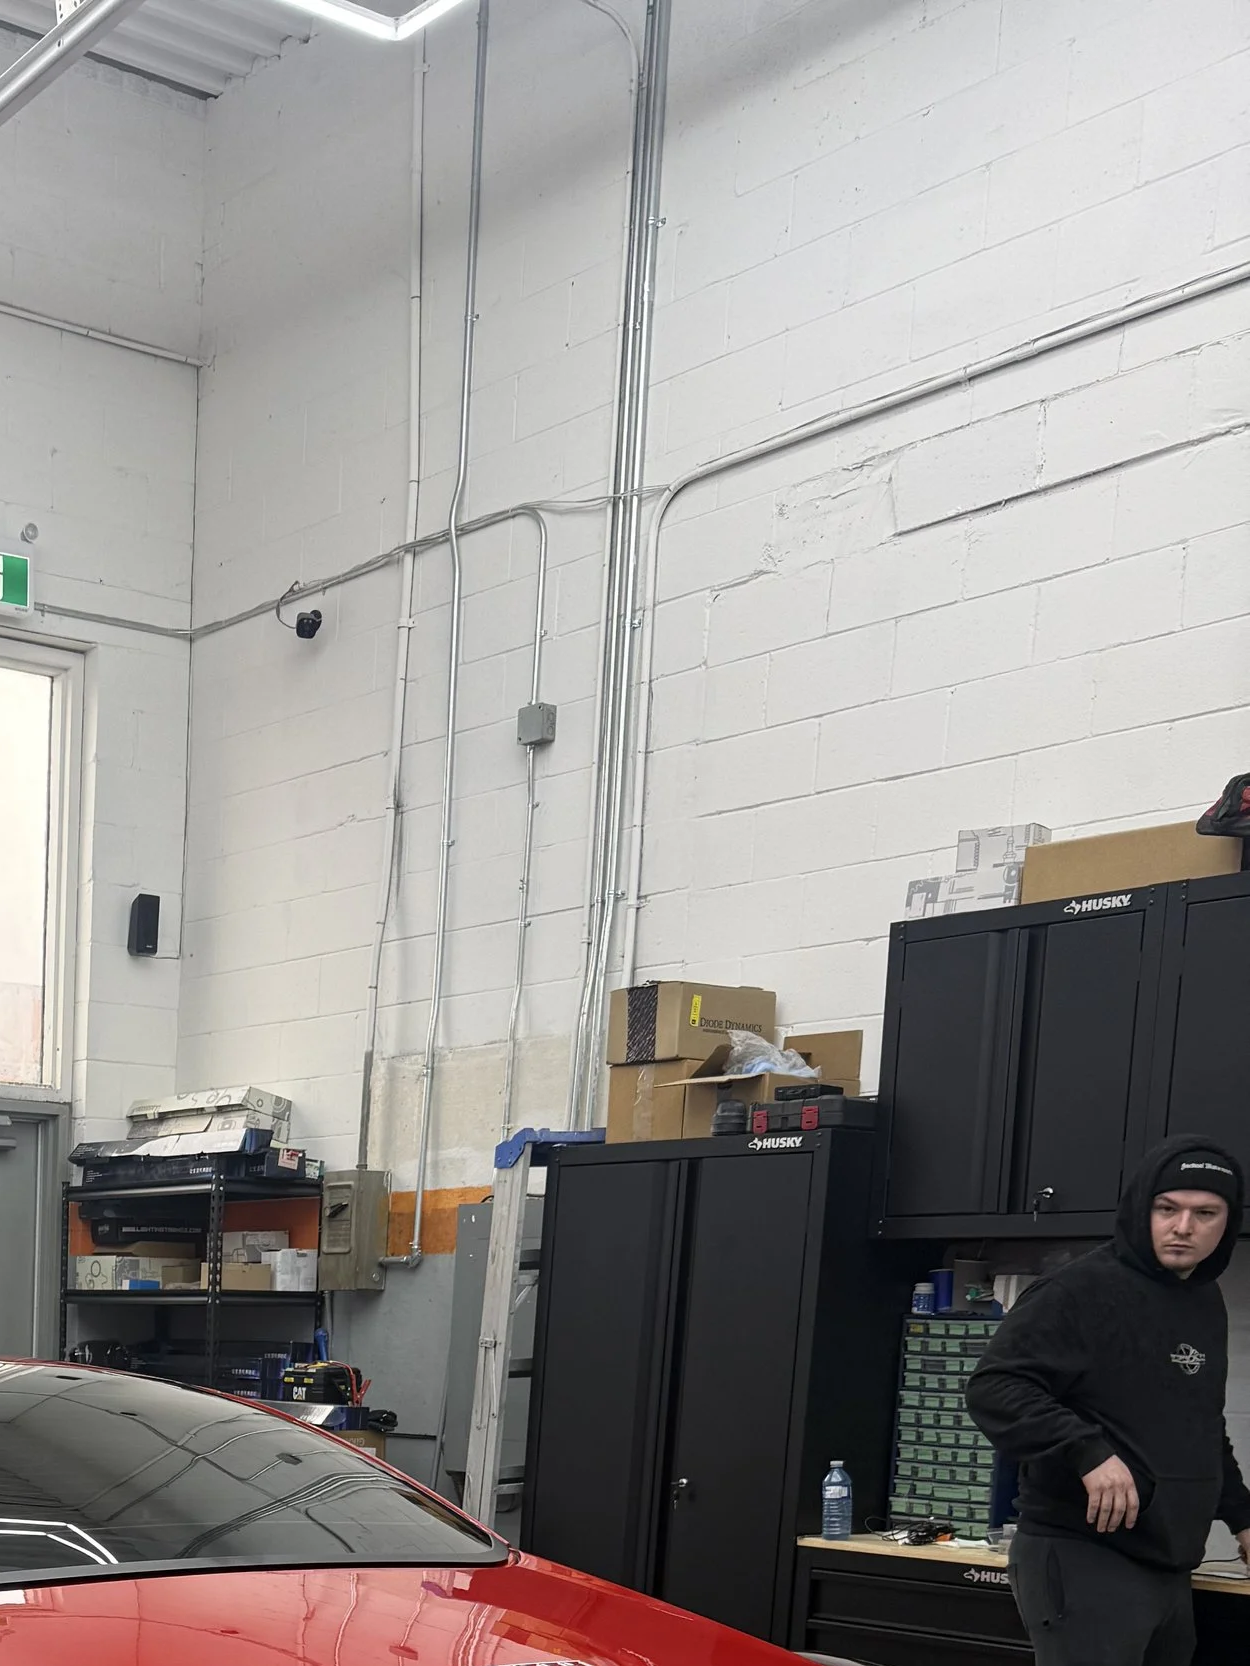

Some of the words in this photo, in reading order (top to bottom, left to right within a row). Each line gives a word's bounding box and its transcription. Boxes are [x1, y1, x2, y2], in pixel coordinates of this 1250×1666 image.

[1081, 894, 1132, 912] HUSKY
[762, 1136, 803, 1149] HUSKY
[292, 1386, 307, 1400] CAT
[980, 1570, 1010, 1585] HUS
